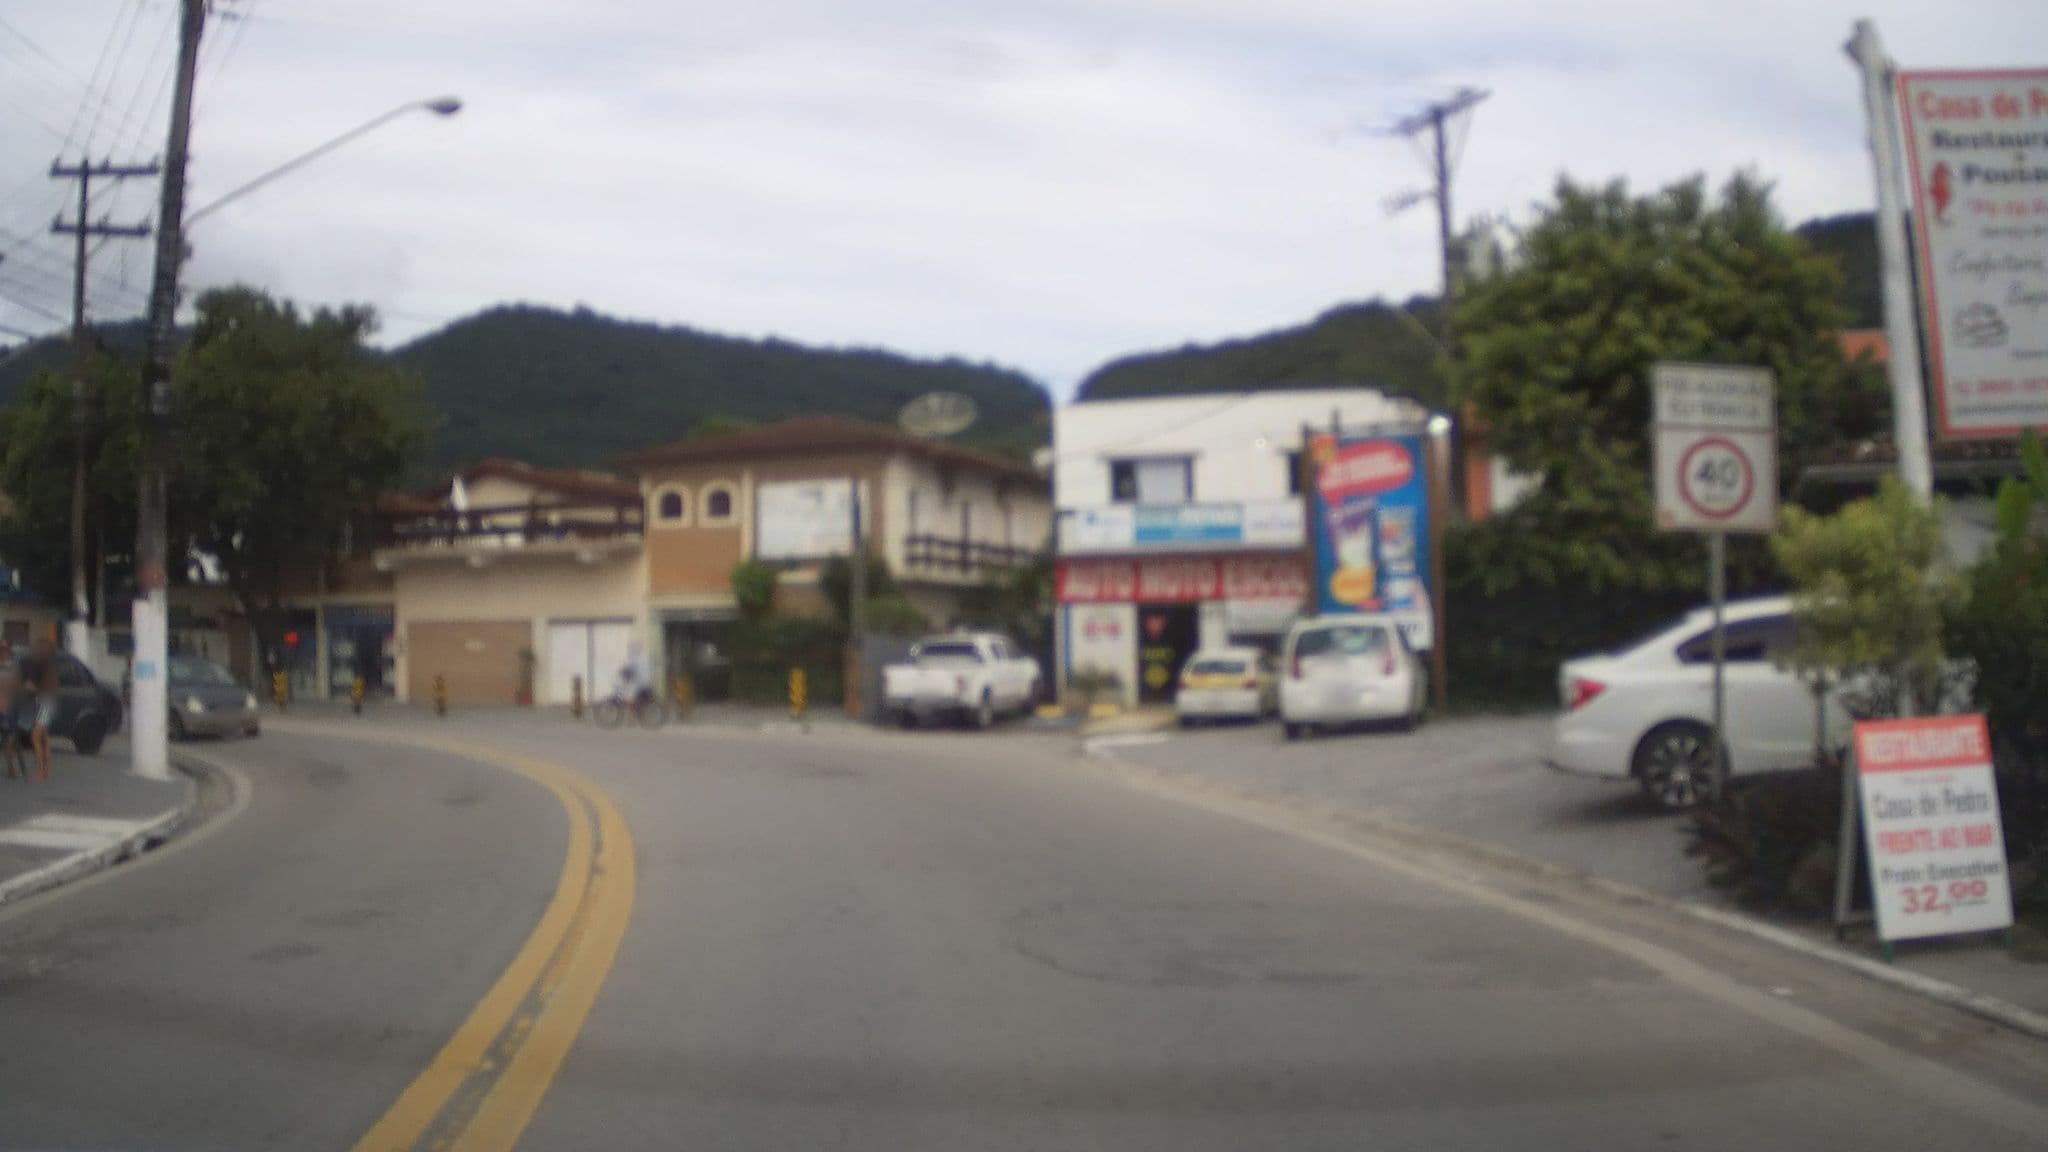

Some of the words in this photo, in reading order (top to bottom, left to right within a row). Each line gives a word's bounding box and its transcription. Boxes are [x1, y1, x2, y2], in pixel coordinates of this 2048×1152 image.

[1917, 90, 1982, 119] Casa
[1991, 90, 2022, 118] de
[1696, 457, 1739, 489] 40
[1064, 563, 1135, 600] AUTO
[1140, 562, 1216, 599] MOTO
[1862, 726, 1985, 765] RESTAURANTE
[1873, 792, 1913, 819] Casa
[1920, 789, 1938, 816] de
[1943, 785, 1990, 814] Pedra
[1877, 828, 1935, 854] FRENTE
[1940, 827, 1960, 850] AO
[1964, 824, 1993, 848] MAR
